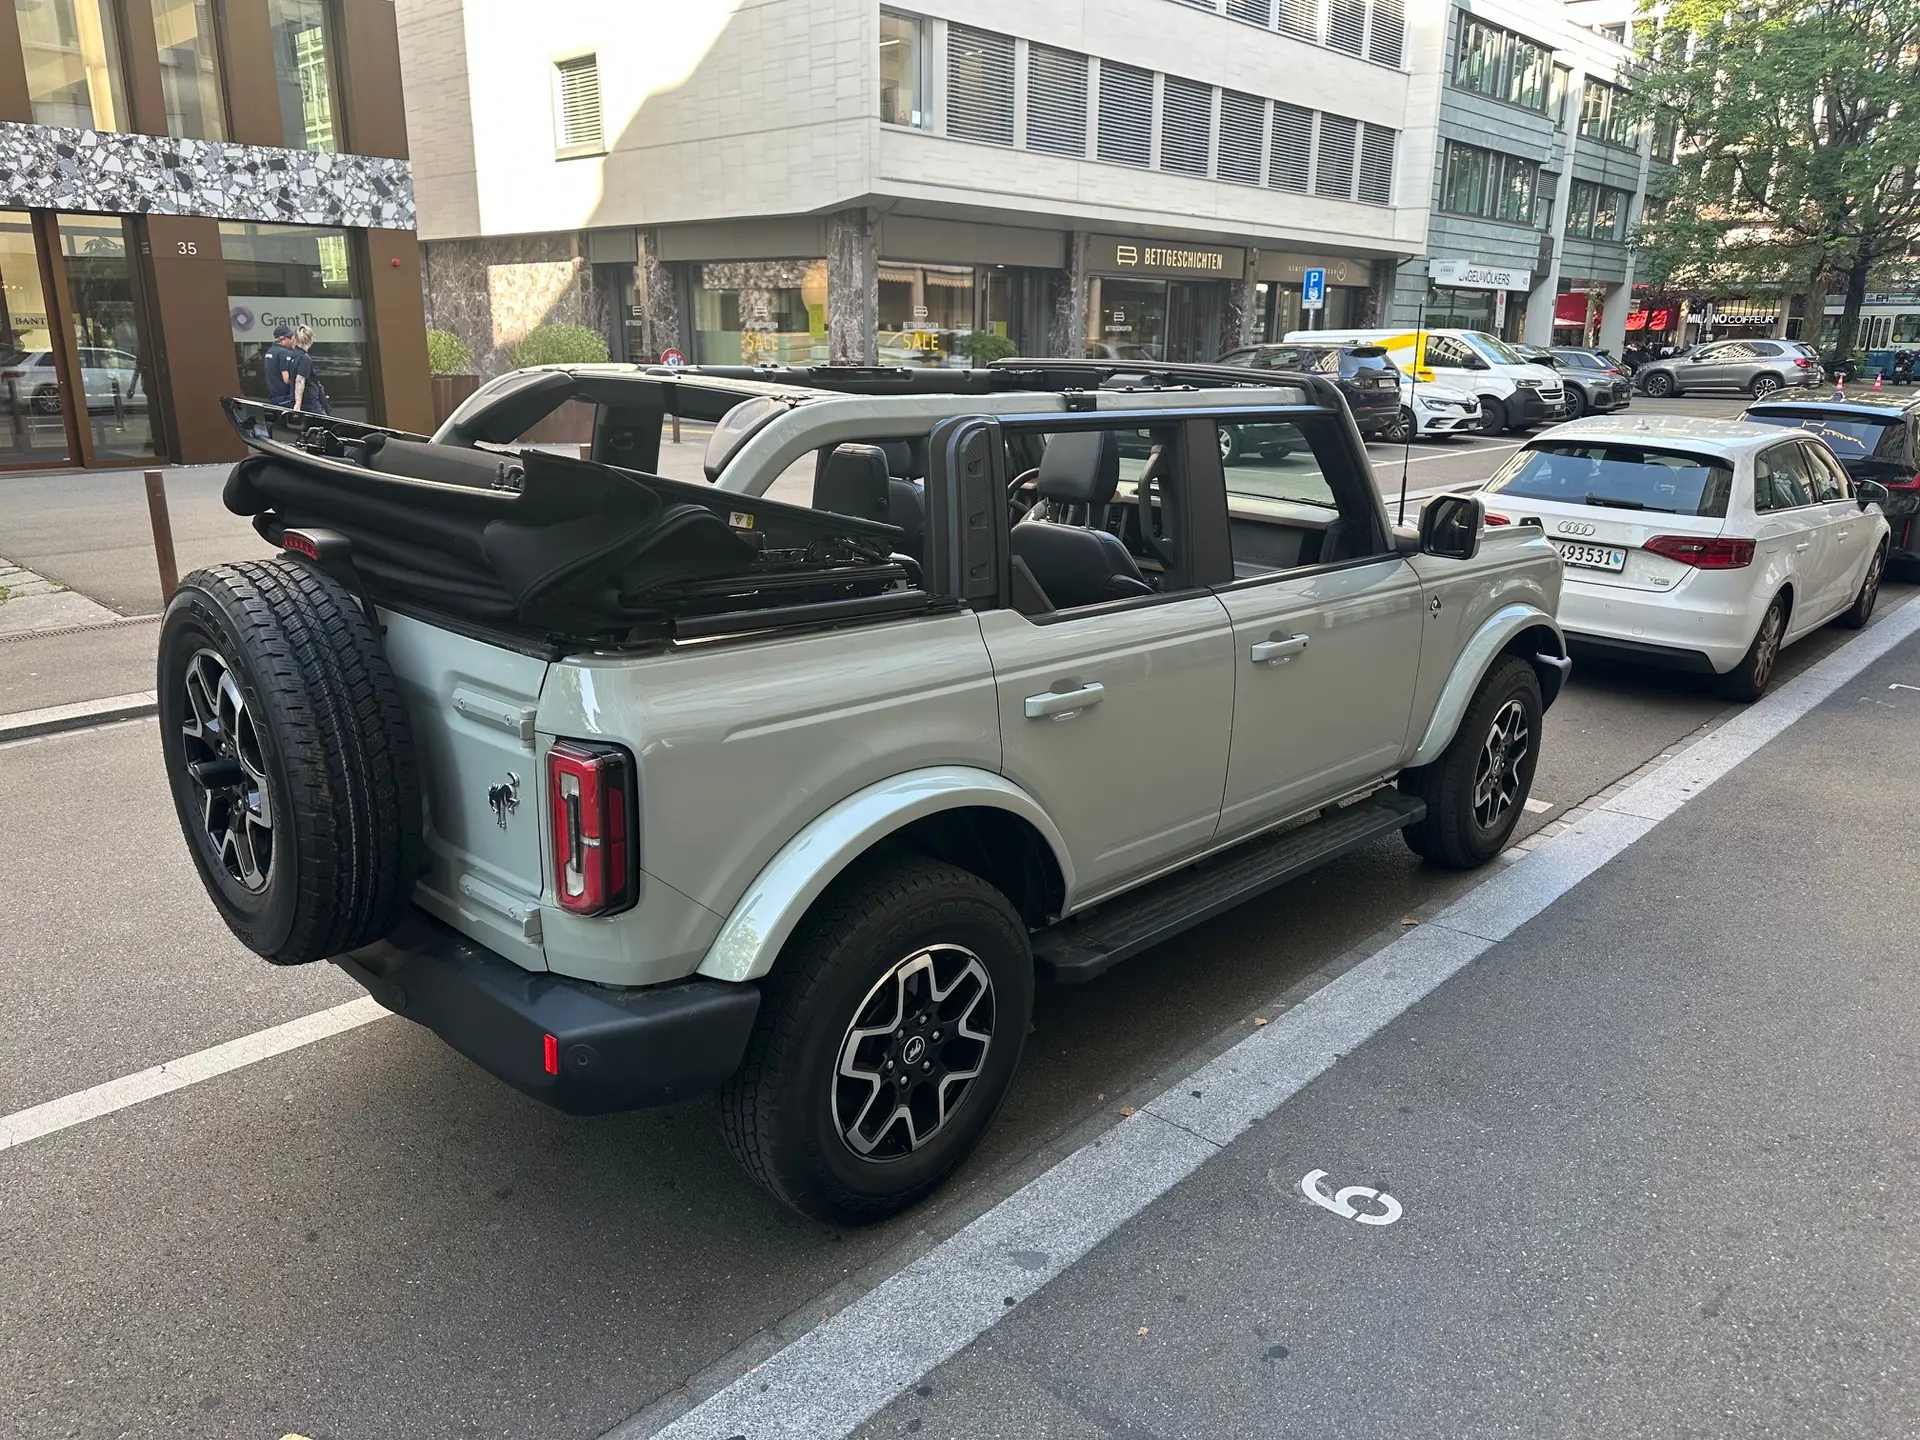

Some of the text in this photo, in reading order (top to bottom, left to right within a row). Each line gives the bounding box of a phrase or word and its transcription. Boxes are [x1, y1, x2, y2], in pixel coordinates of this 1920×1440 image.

[177, 241, 197, 255] 35
[1144, 247, 1223, 270] BETTGESCHICHTEN
[1310, 272, 1319, 287] P
[261, 311, 362, 328] Grant Thornton
[1728, 315, 1774, 324] COIFFEUR
[746, 332, 779, 351] SALE
[902, 333, 939, 351] SALE
[1301, 1168, 1403, 1226] 6
